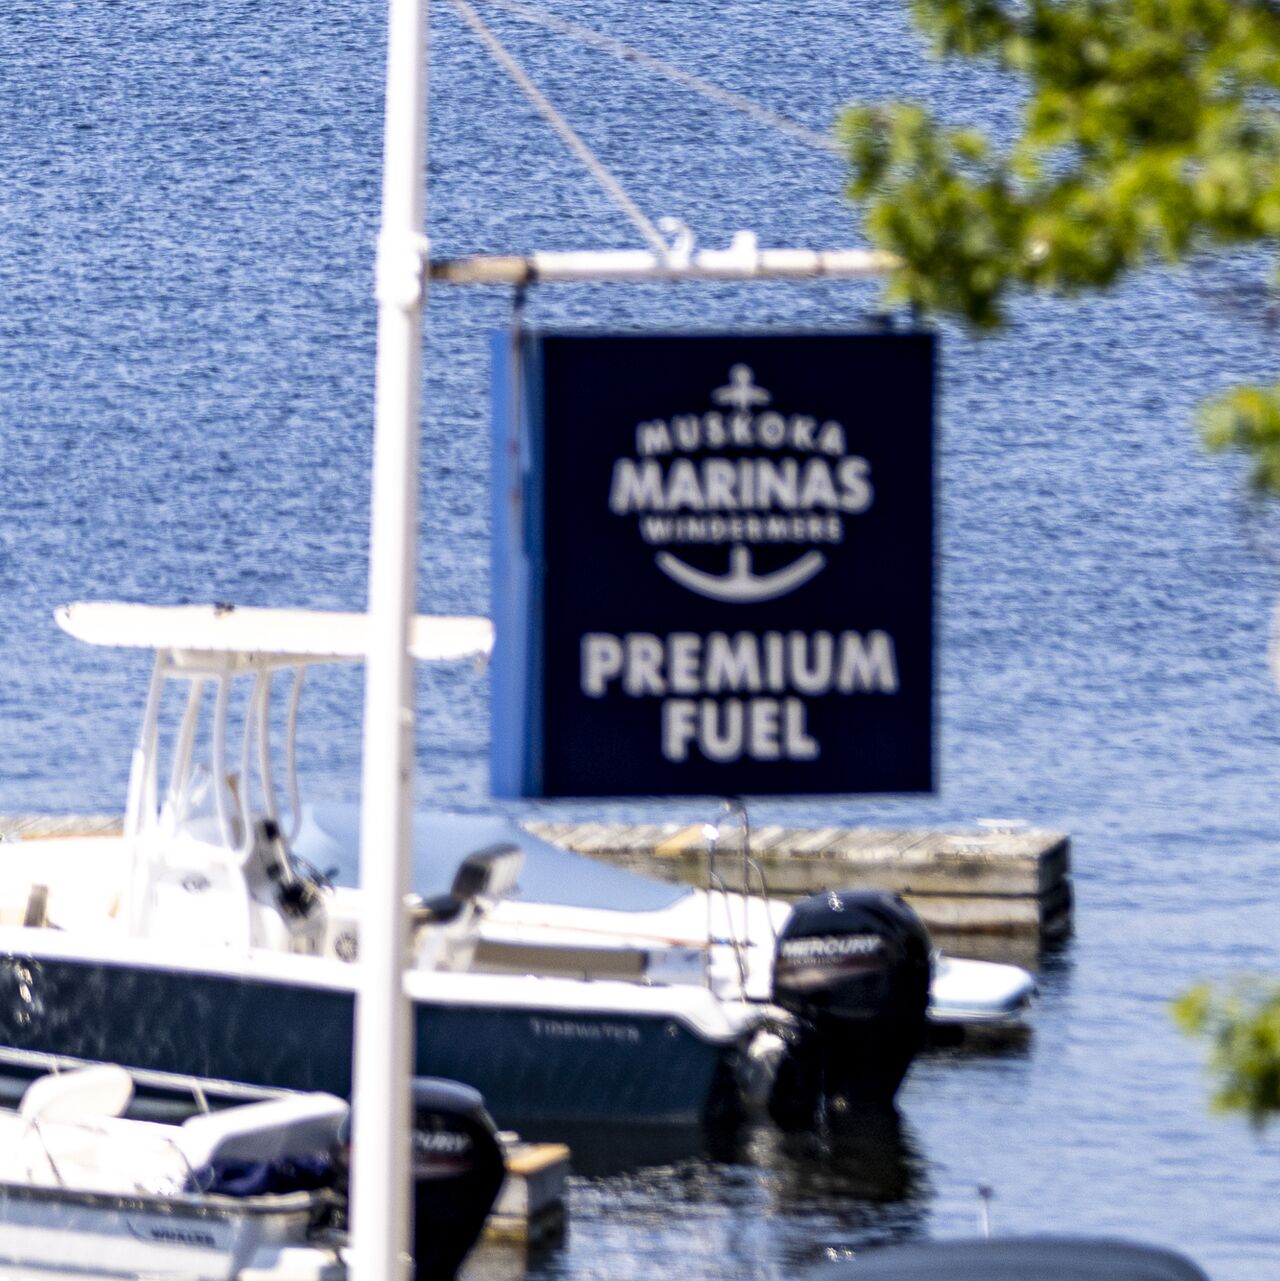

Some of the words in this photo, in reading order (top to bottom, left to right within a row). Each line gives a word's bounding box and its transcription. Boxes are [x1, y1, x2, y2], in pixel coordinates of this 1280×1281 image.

[637, 412, 844, 454] MUSKOKA
[611, 456, 873, 513] MARINAS
[581, 631, 898, 697] PREMIUM
[662, 697, 818, 762] FUEL
[782, 934, 882, 957] MERCURY
